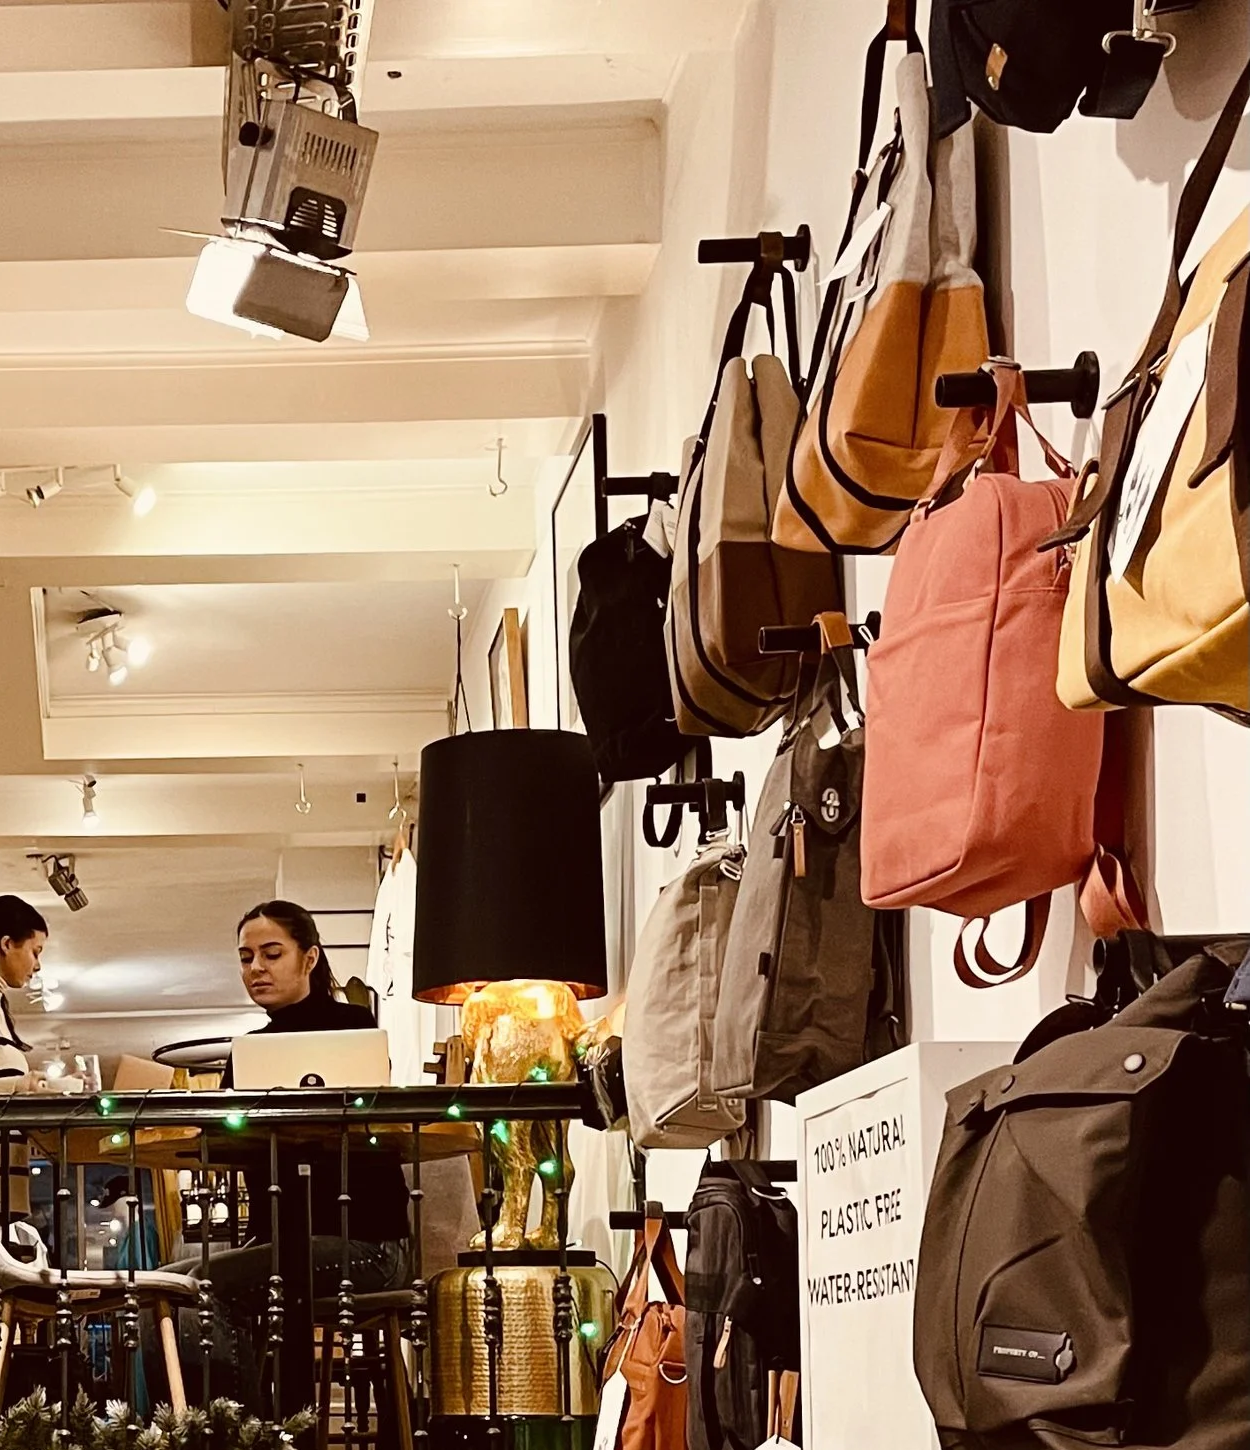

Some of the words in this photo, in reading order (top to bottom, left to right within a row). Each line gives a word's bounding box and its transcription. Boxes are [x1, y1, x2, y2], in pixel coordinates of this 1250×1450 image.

[814, 1135, 846, 1174] 100%
[848, 1114, 905, 1164] NATURAL
[821, 1198, 872, 1239] PLASTIC
[875, 1188, 901, 1227] FREE
[807, 1259, 914, 1306] WATER-RESISTANT
